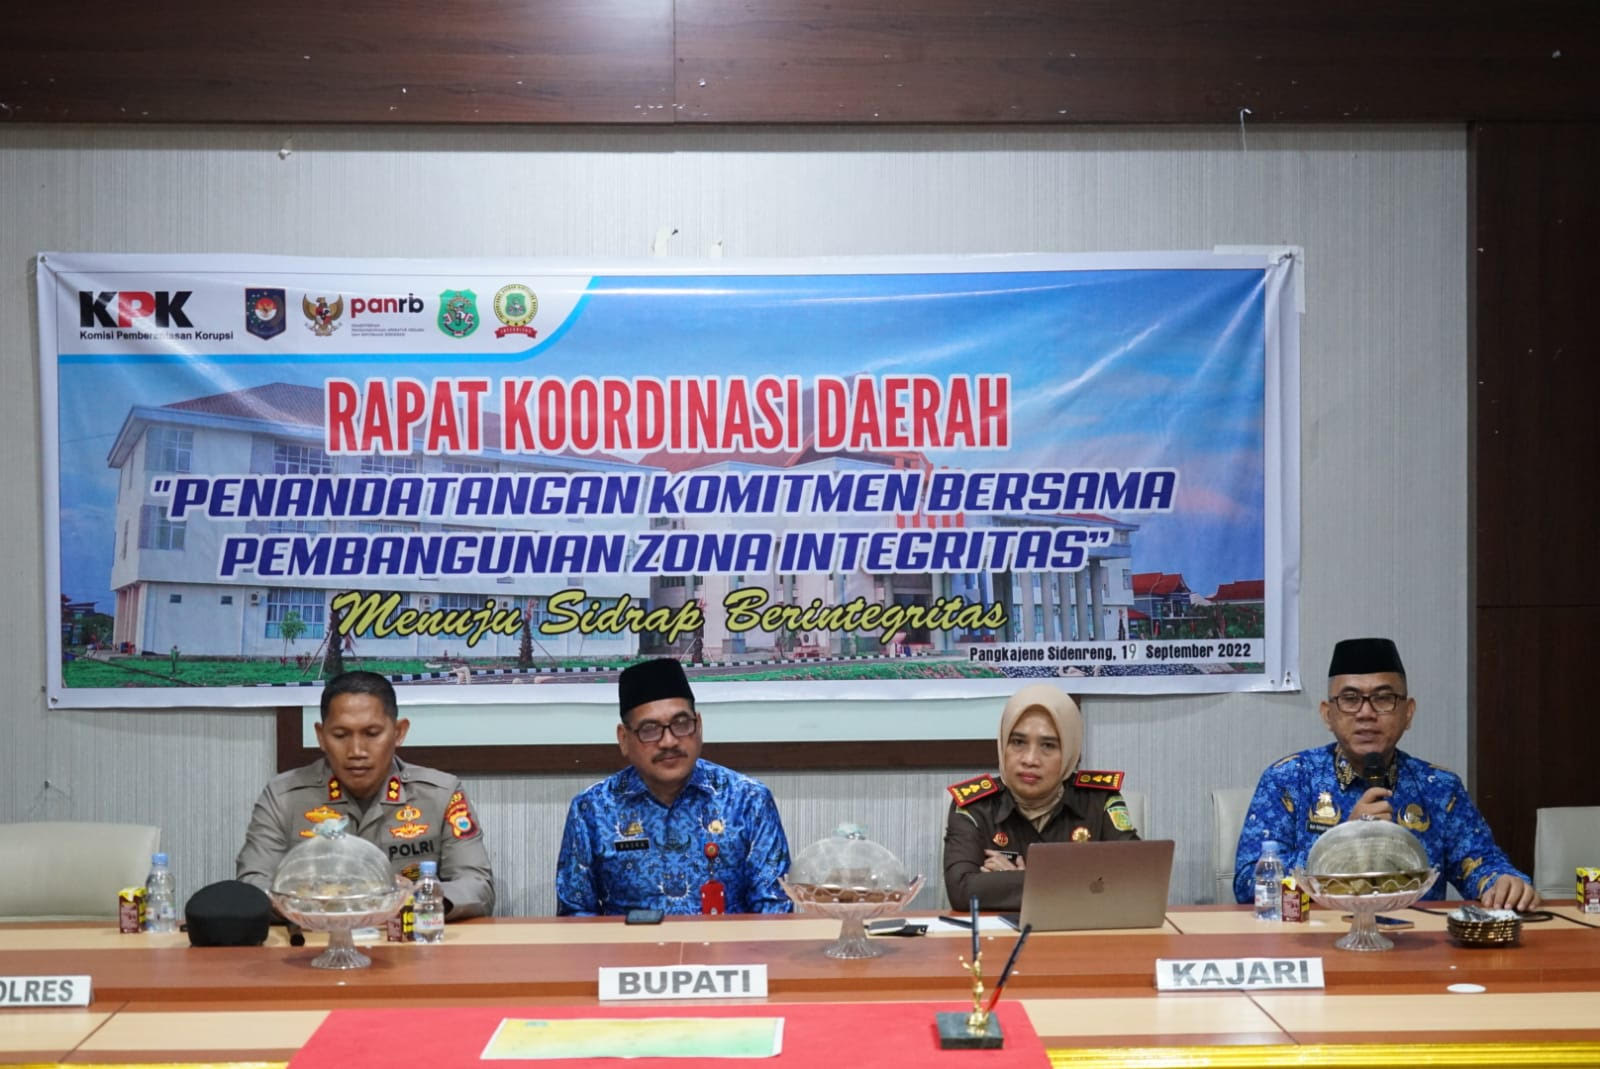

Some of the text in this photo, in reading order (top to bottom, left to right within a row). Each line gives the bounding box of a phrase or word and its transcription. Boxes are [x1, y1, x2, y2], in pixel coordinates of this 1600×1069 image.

[79, 291, 194, 328] KPK
[350, 293, 424, 318] panrb
[80, 330, 233, 342] Komisi Pemberasan Korupsi
[327, 376, 1009, 452] RAPAT KOORDINASI DAERAH
[647, 471, 923, 515] KOMITMEN
[928, 470, 1177, 513] BERSAMA
[218, 533, 627, 577] PEMBANGUNAN
[631, 532, 773, 573] ZONA
[331, 587, 1009, 648] Menuju Sidrap Berintegritas
[969, 642, 1252, 663] Pangkajene Sidenreng, 19 September 2022
[388, 840, 434, 861] POLRI
[618, 970, 751, 995] BUPATI
[1172, 960, 1310, 986] KAJARI
